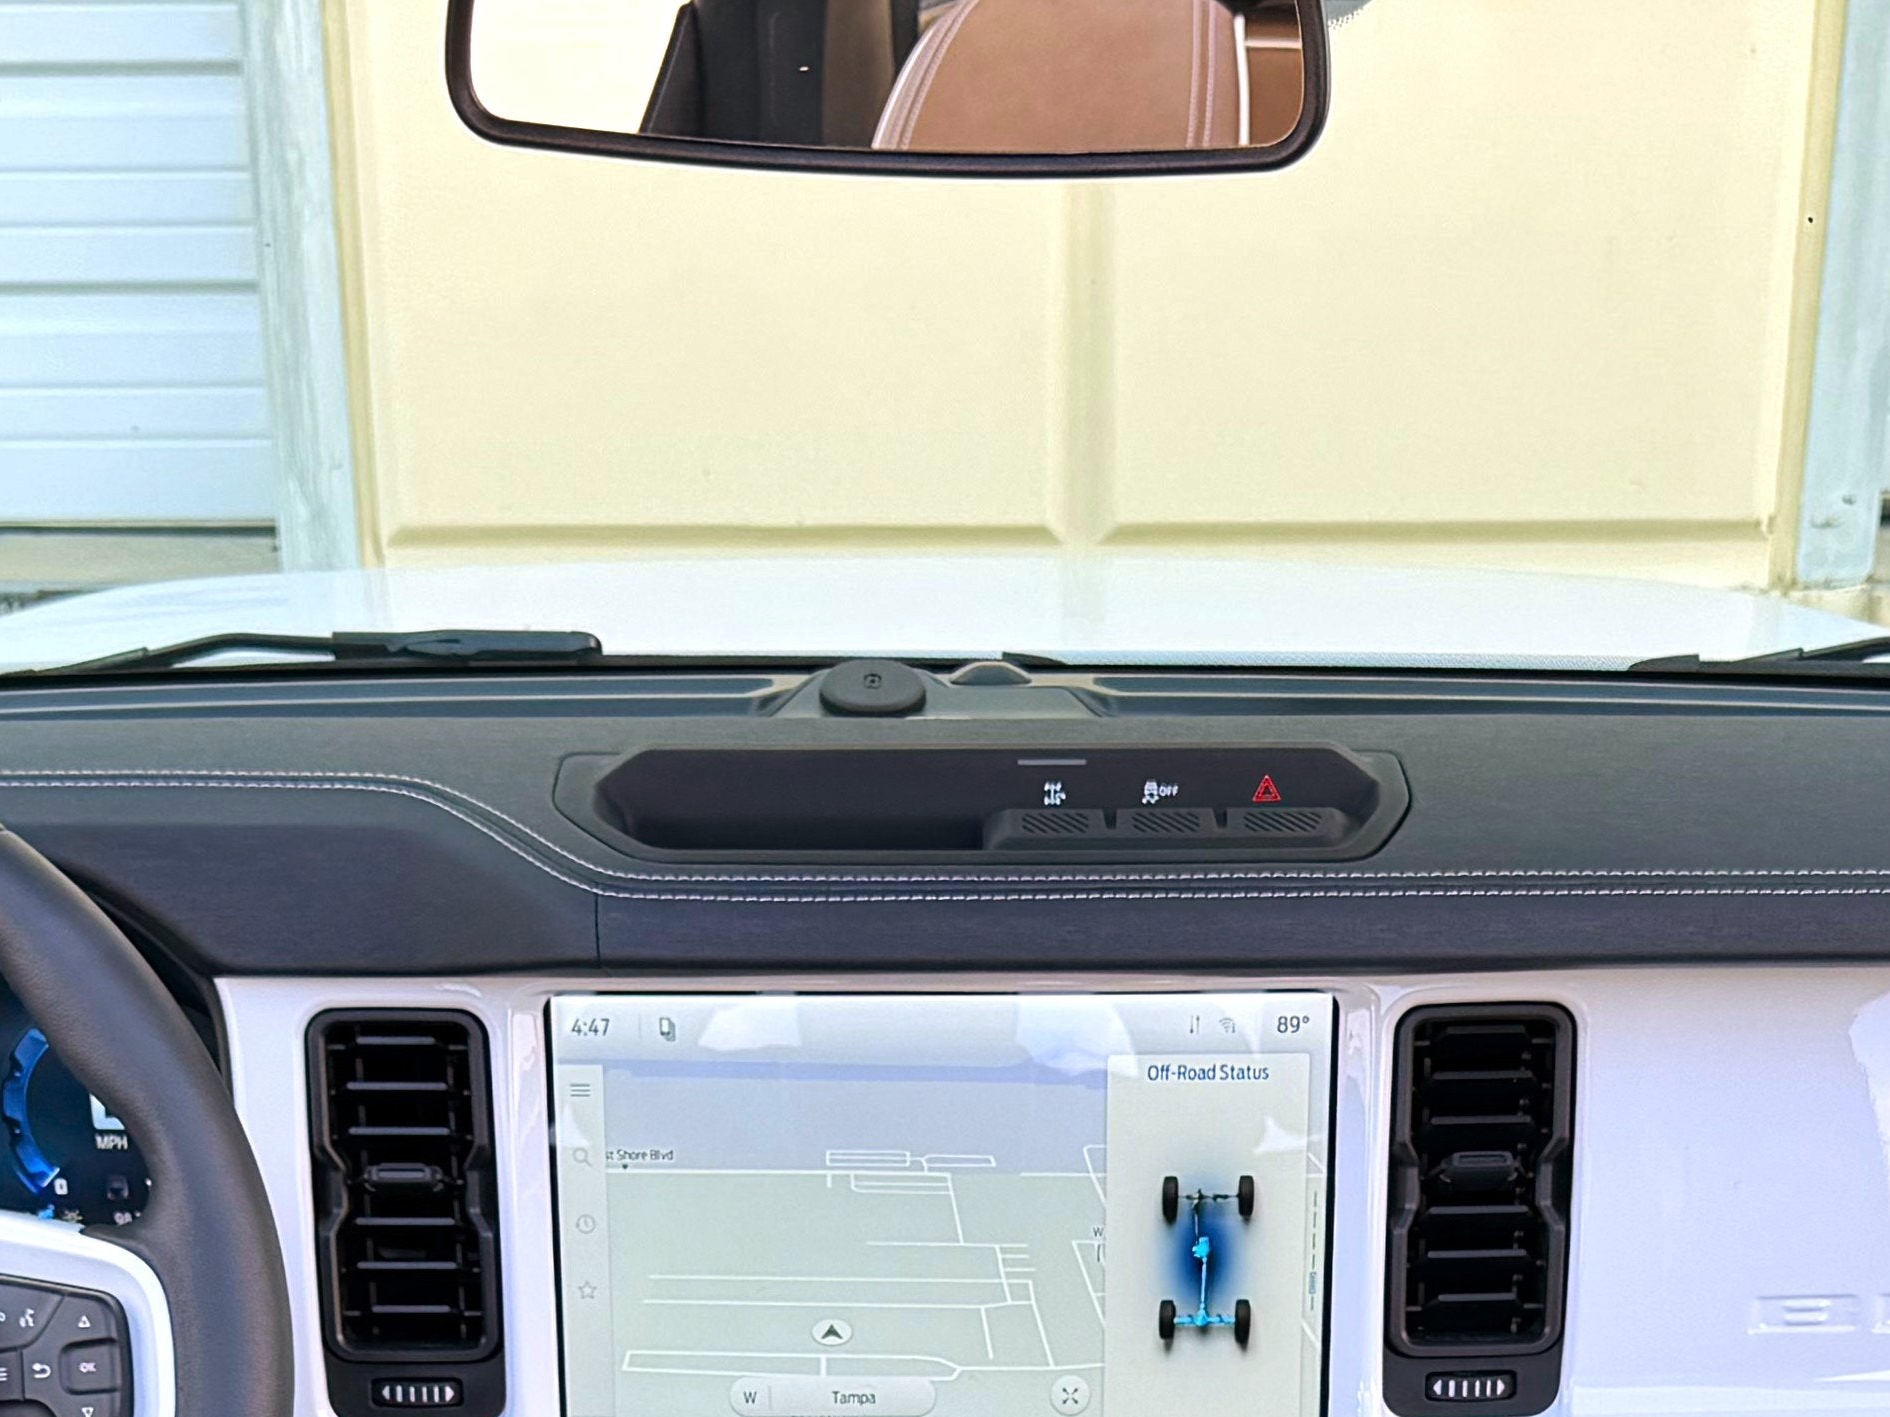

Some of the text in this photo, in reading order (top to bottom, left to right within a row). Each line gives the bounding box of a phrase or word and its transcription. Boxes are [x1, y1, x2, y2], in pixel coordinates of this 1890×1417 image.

[1159, 783, 1179, 797] OFF
[571, 1018, 610, 1037] 4:47
[1276, 1015, 1310, 1034] 89°
[1147, 1064, 1269, 1081] Off-Road Status
[95, 1133, 128, 1151] MPH
[616, 1149, 648, 1161] Shore
[649, 1149, 674, 1161] Blvd
[53, 1178, 68, 1195] 0
[79, 1362, 97, 1373] OK
[743, 1391, 758, 1404] W
[832, 1390, 877, 1406] Tampa
